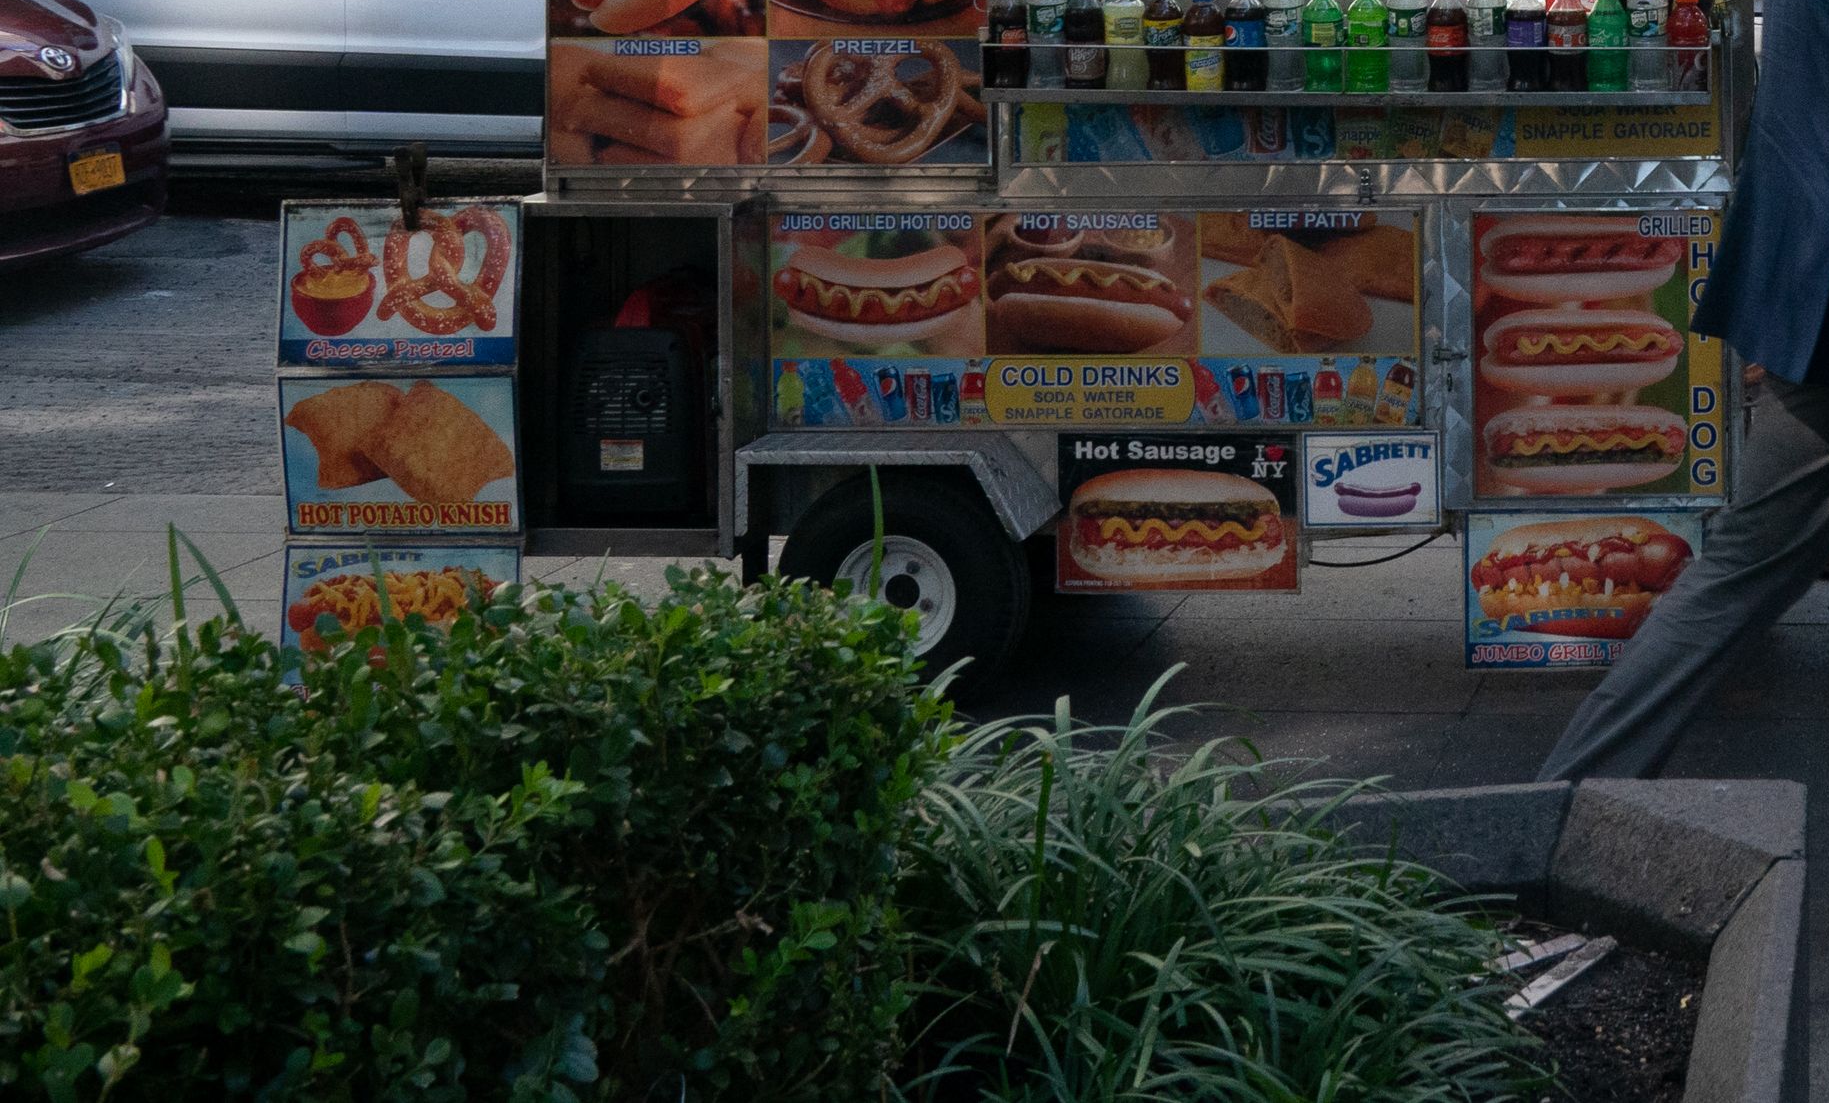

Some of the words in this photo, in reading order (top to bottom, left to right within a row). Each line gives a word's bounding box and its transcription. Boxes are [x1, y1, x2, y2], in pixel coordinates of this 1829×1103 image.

[614, 39, 701, 56] KNISHES
[832, 38, 922, 56] PRETZEL
[1522, 123, 1604, 140] SNAPPLE
[1612, 122, 1712, 139] GATORADE
[781, 213, 826, 232] JUBO
[829, 213, 897, 231] GRILLED
[899, 213, 934, 231] HOT
[936, 213, 973, 231] DOG
[1021, 213, 1063, 231] HOT
[1065, 212, 1159, 231] SAUSAGE
[1249, 211, 1302, 230] BEEF
[1306, 211, 1363, 230] PATTY
[1637, 215, 1714, 237] GRILLED
[306, 339, 388, 360] Cheese
[394, 339, 475, 359] Pretzel
[1001, 365, 1074, 389] COLD
[1081, 364, 1180, 388] DRINKS
[1033, 390, 1079, 404] SODA
[1082, 390, 1136, 403] WATER
[1004, 406, 1073, 421] SNAPPLE
[1081, 406, 1165, 421] GATORADE
[1690, 386, 1719, 488] DOG
[1074, 440, 1120, 461] Hot
[1127, 440, 1236, 465] Sausage
[1254, 444, 1266, 462] I
[1251, 460, 1288, 479] NY
[1313, 440, 1431, 487] SABRETT
[297, 501, 344, 528] HOT
[347, 501, 436, 528] POTATO
[437, 501, 513, 528] KNISH
[1472, 607, 1625, 638] SABRETT
[1471, 643, 1545, 664] JUMBO
[1548, 642, 1605, 663] GRILL
